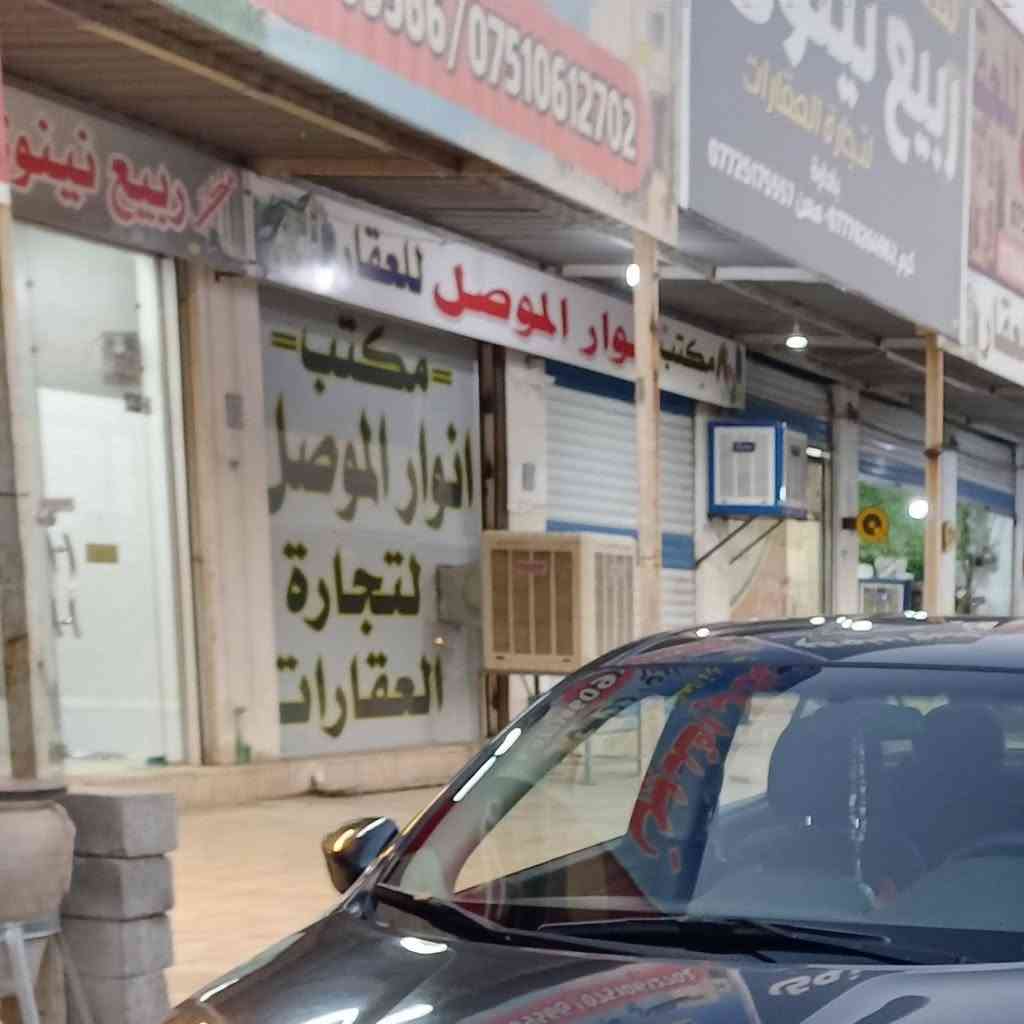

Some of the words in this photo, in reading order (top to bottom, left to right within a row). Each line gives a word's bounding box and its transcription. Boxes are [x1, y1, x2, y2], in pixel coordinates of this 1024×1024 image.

[15, 118, 97, 205] نينو
[110, 156, 187, 227] ربيع
[433, 263, 568, 342] الموصل
[579, 311, 636, 367] وار
[301, 315, 429, 396] مكتب
[266, 391, 388, 524] الموصل
[395, 420, 474, 530] انوار
[282, 541, 422, 636] لتجارة
[275, 651, 444, 739] العقارات
